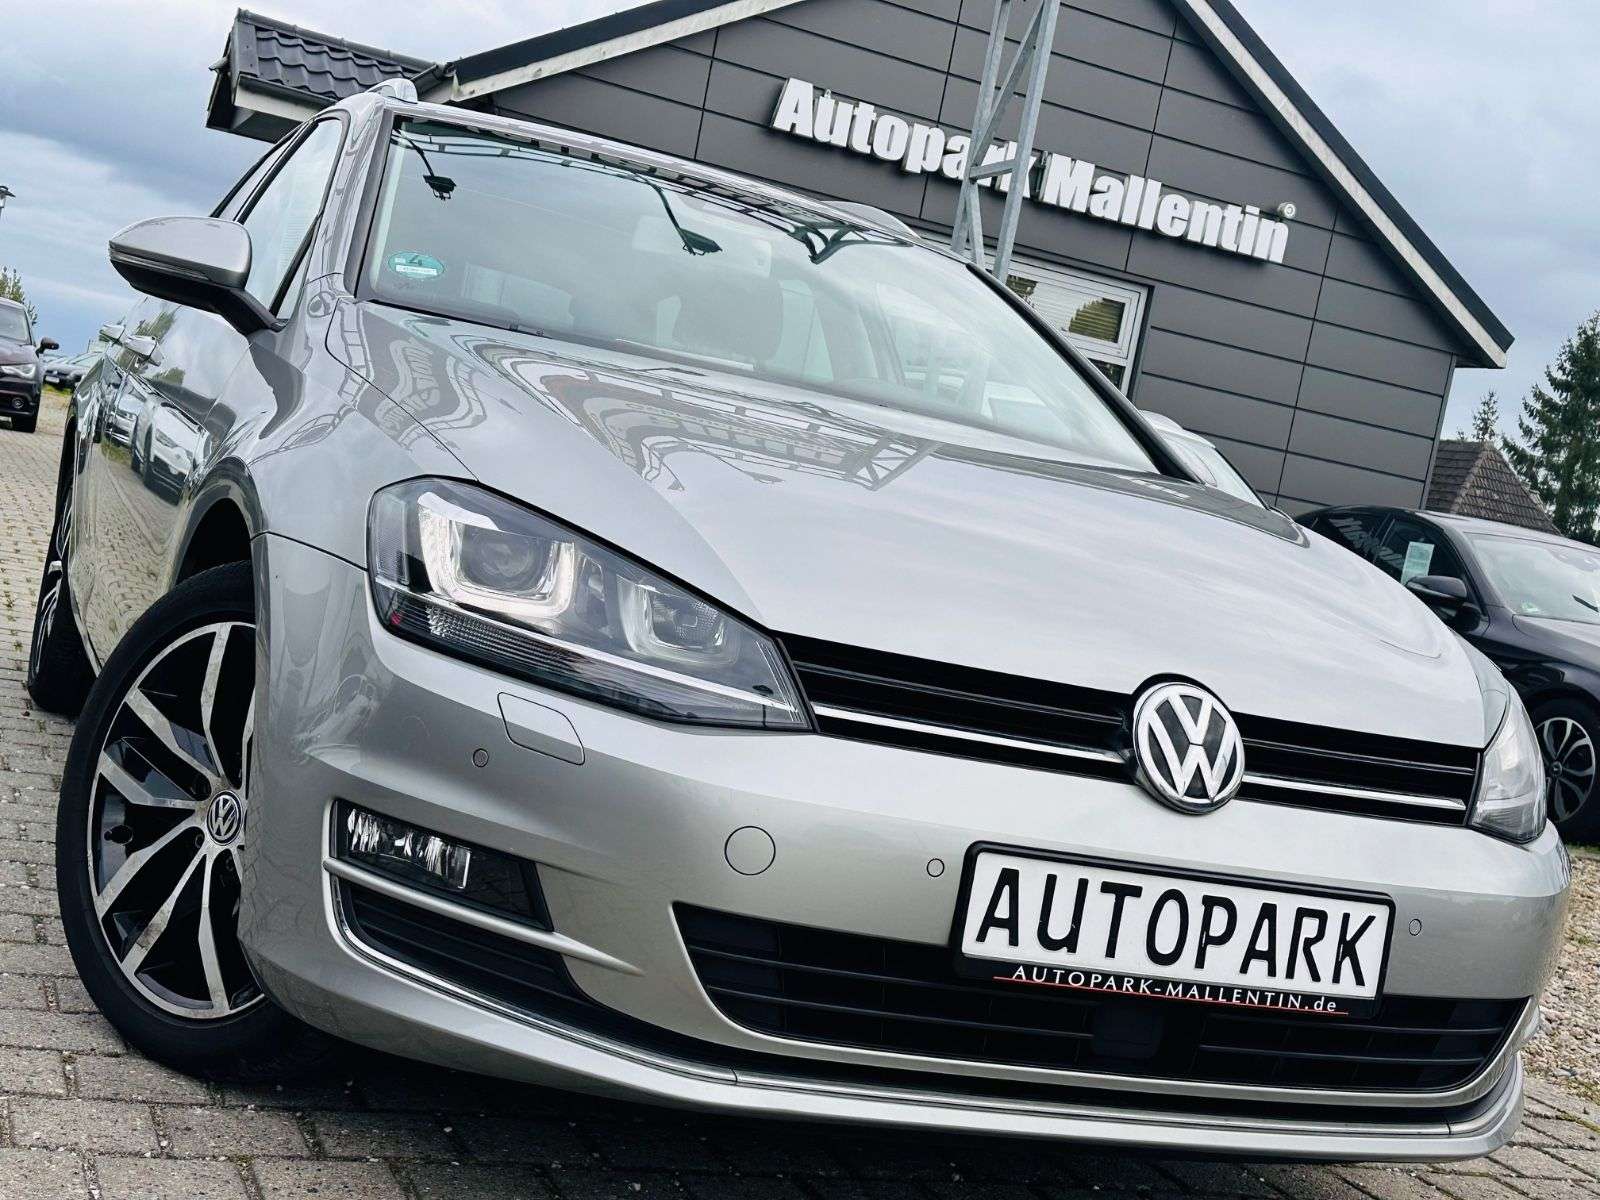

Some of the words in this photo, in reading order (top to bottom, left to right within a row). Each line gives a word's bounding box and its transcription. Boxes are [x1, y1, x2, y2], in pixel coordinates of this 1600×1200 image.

[1041, 152, 1289, 264] Mallentin
[974, 867, 1377, 987] AUTOPARK
[1011, 965, 1337, 1013] AUTOPARK-MALLENTIN.de
